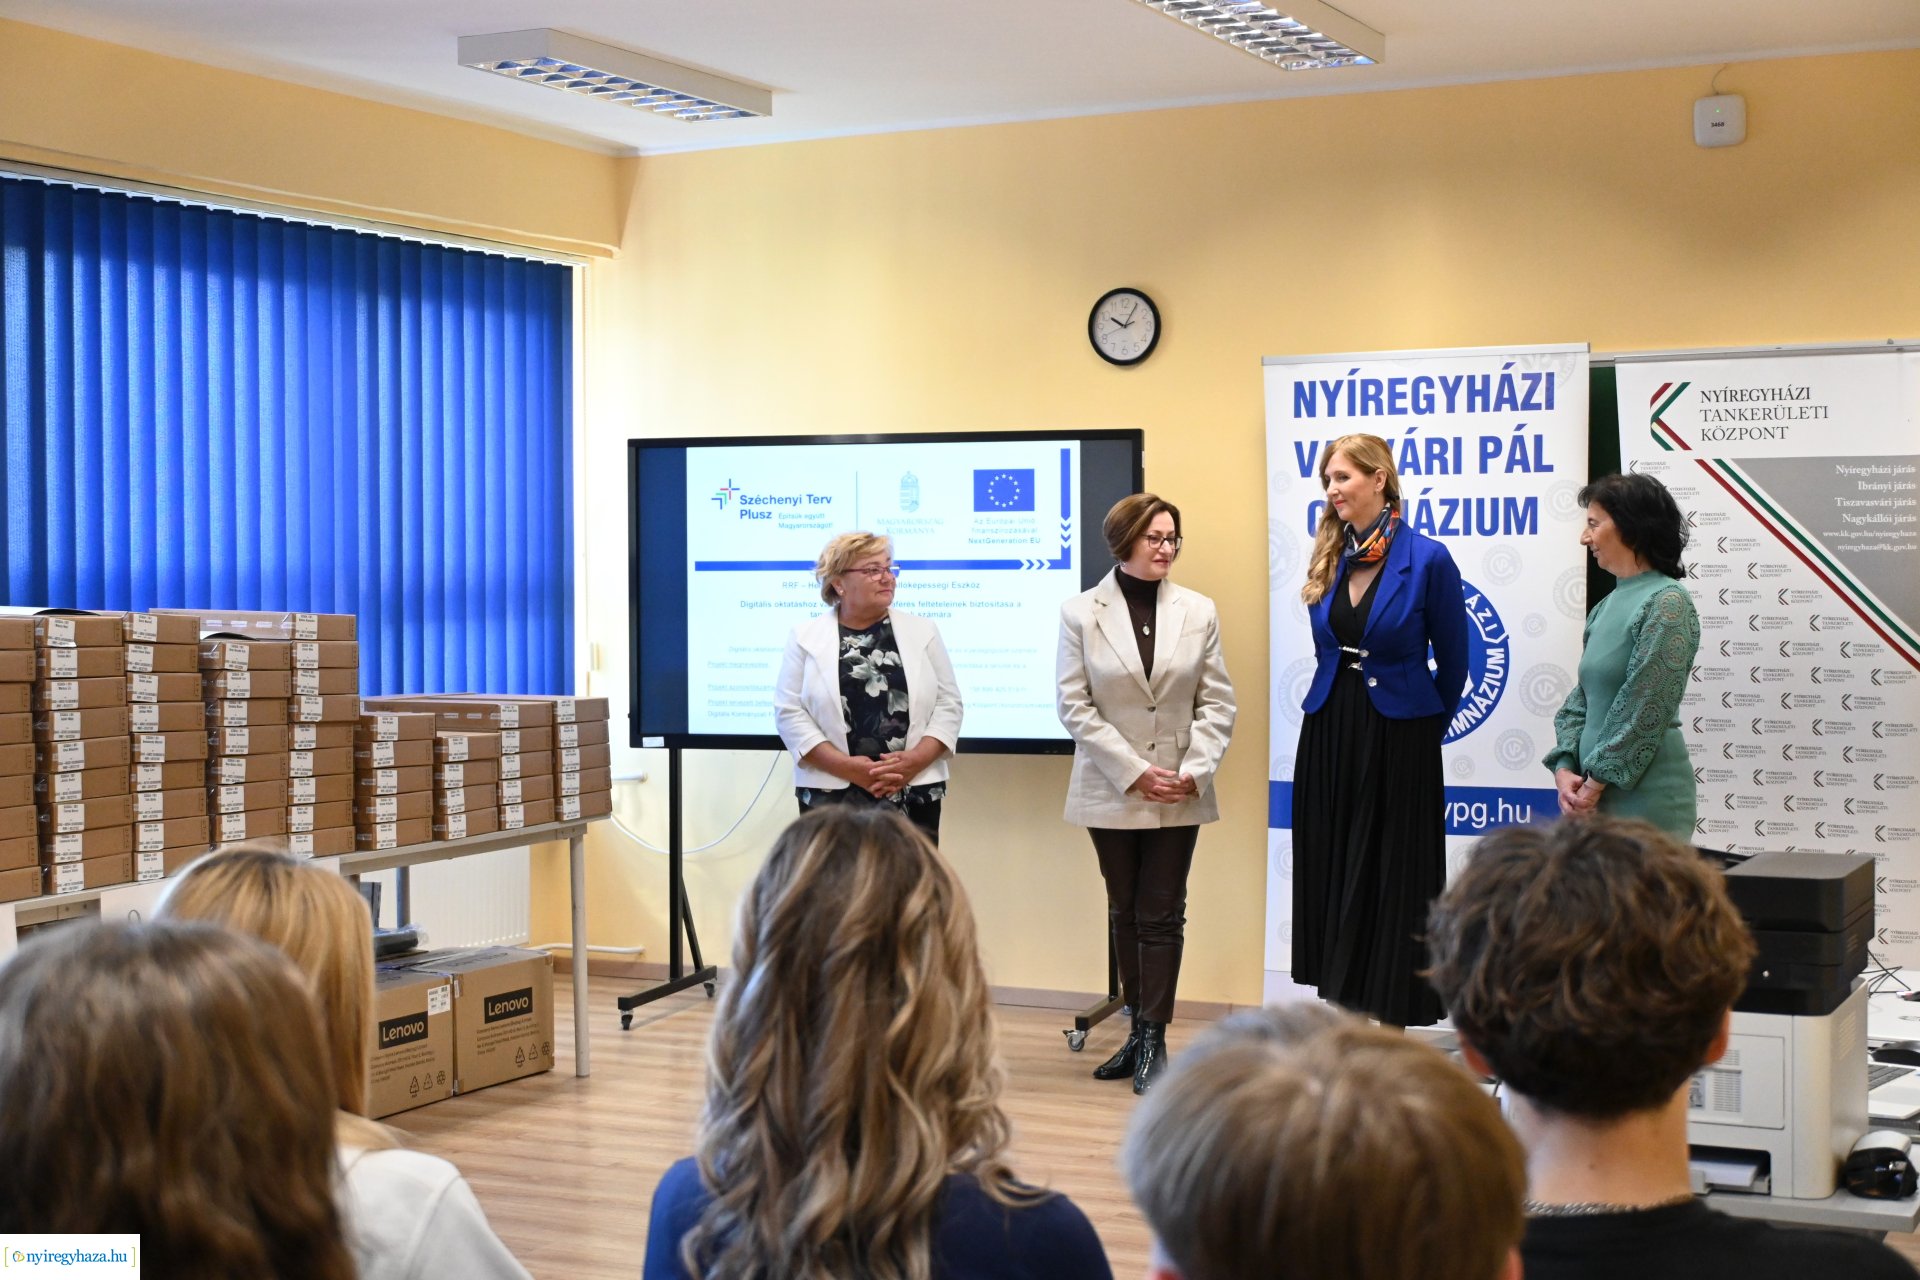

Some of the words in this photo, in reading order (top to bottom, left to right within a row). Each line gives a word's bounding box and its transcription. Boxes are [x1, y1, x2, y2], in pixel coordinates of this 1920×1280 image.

[1294, 362, 1554, 418] NYÍREGYHÁZI
[1700, 384, 1810, 403] NYÍREGYHÁZI
[1700, 404, 1829, 422] TANKERÜLETI
[1700, 426, 1788, 441] KÖZPONT
[1294, 427, 1462, 478] VÁRI
[1479, 424, 1554, 474] PÁL
[1836, 465, 1891, 476] Nyíregyházi
[1892, 465, 1916, 476] járás
[1858, 481, 1891, 492] Ibrányi
[1893, 481, 1915, 492] járás
[740, 494, 801, 506] Széchenyi
[806, 494, 832, 504] Terv
[1834, 497, 1891, 506] Tiszavasvári
[1893, 498, 1916, 508] járás
[740, 509, 772, 519] Plusz
[1307, 488, 1538, 538] GÁZIUM
[1842, 514, 1892, 525] Nagykállói
[1894, 514, 1916, 525] járás
[896, 581, 949, 590] llóképességi
[1443, 648, 1506, 740] IMNÁZIUM
[488, 997, 529, 1016] Lenovo
[383, 1021, 424, 1042] Lenovo
